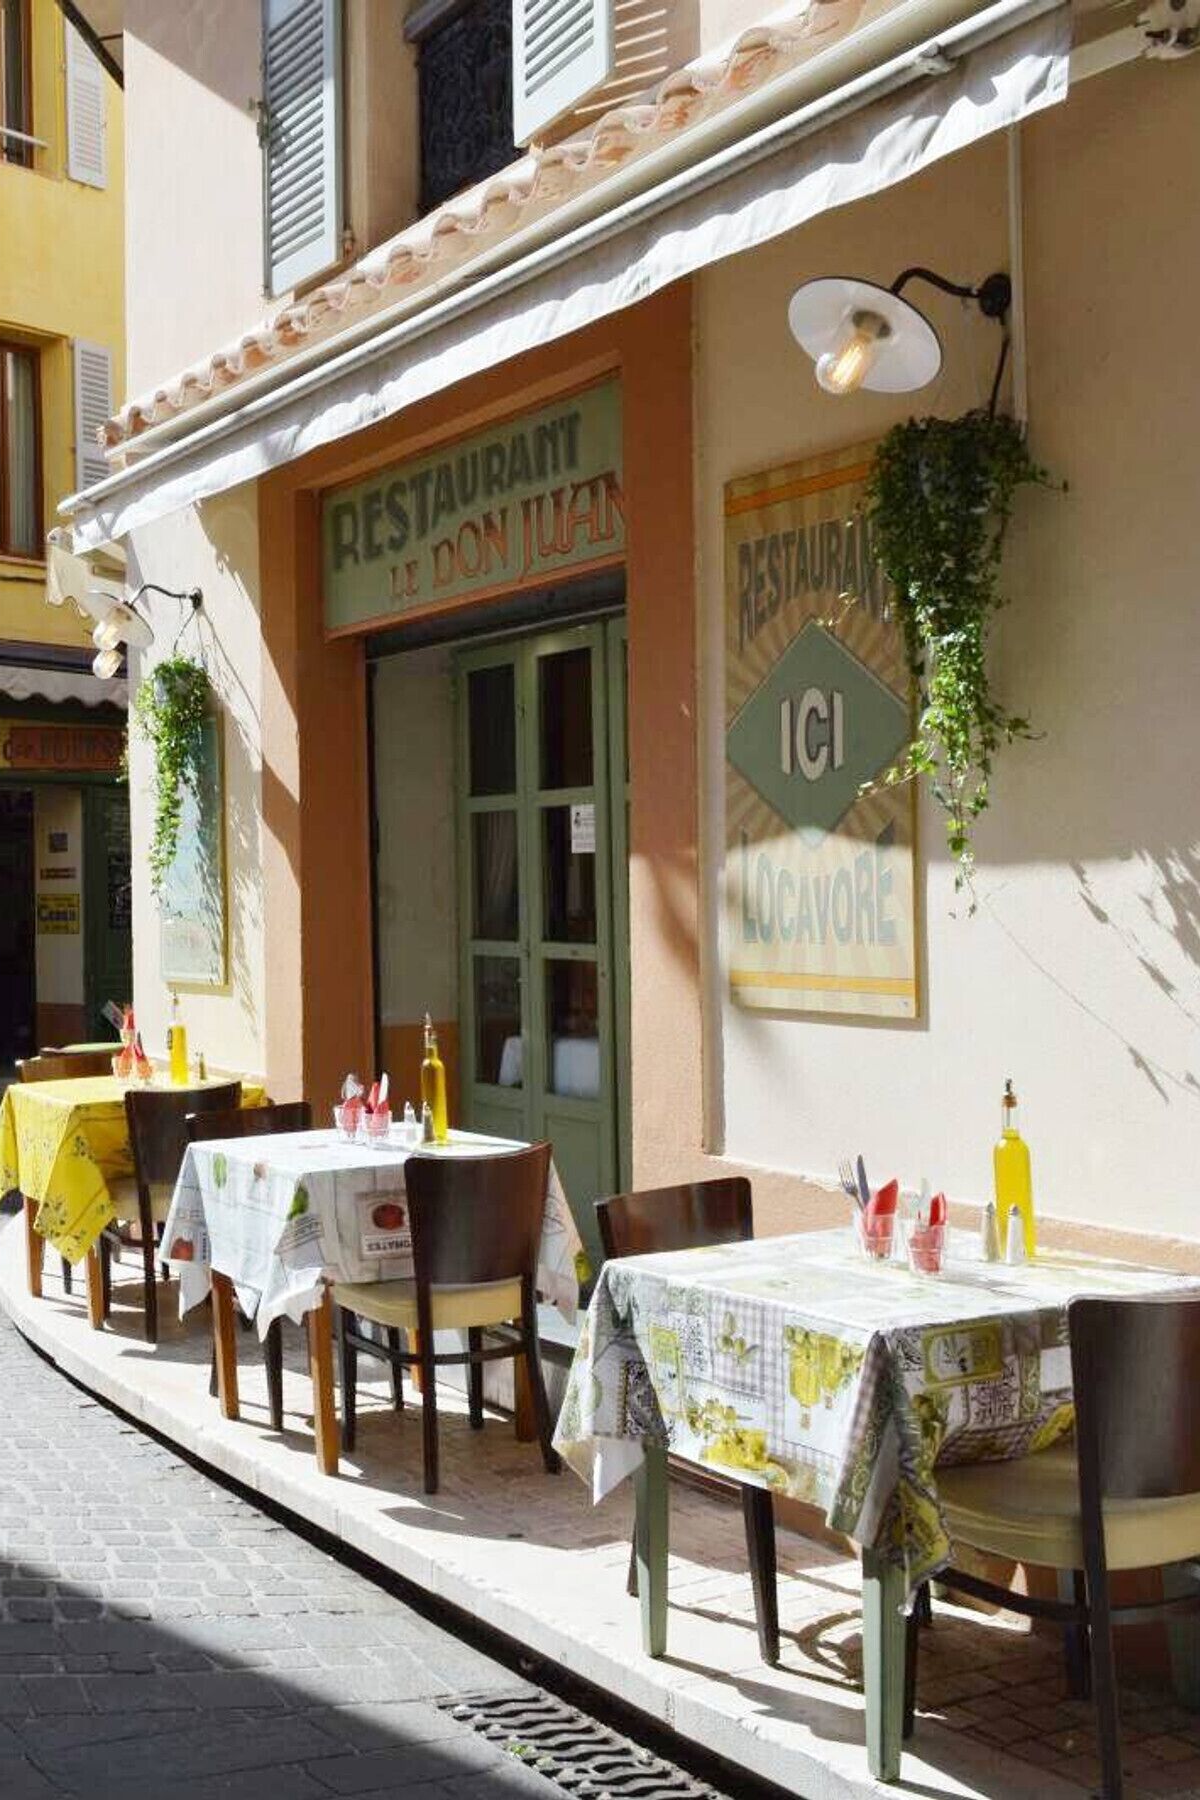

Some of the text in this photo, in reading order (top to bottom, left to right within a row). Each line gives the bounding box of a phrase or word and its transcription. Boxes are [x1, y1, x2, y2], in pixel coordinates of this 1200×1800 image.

[332, 410, 583, 571] RESTAURANT
[390, 470, 624, 600] LE DON JUAN
[737, 512, 890, 654] RESTAURAN
[780, 686, 844, 782] ICI
[741, 817, 896, 947] LOCAVORE
[367, 1239, 412, 1252] OMATES
